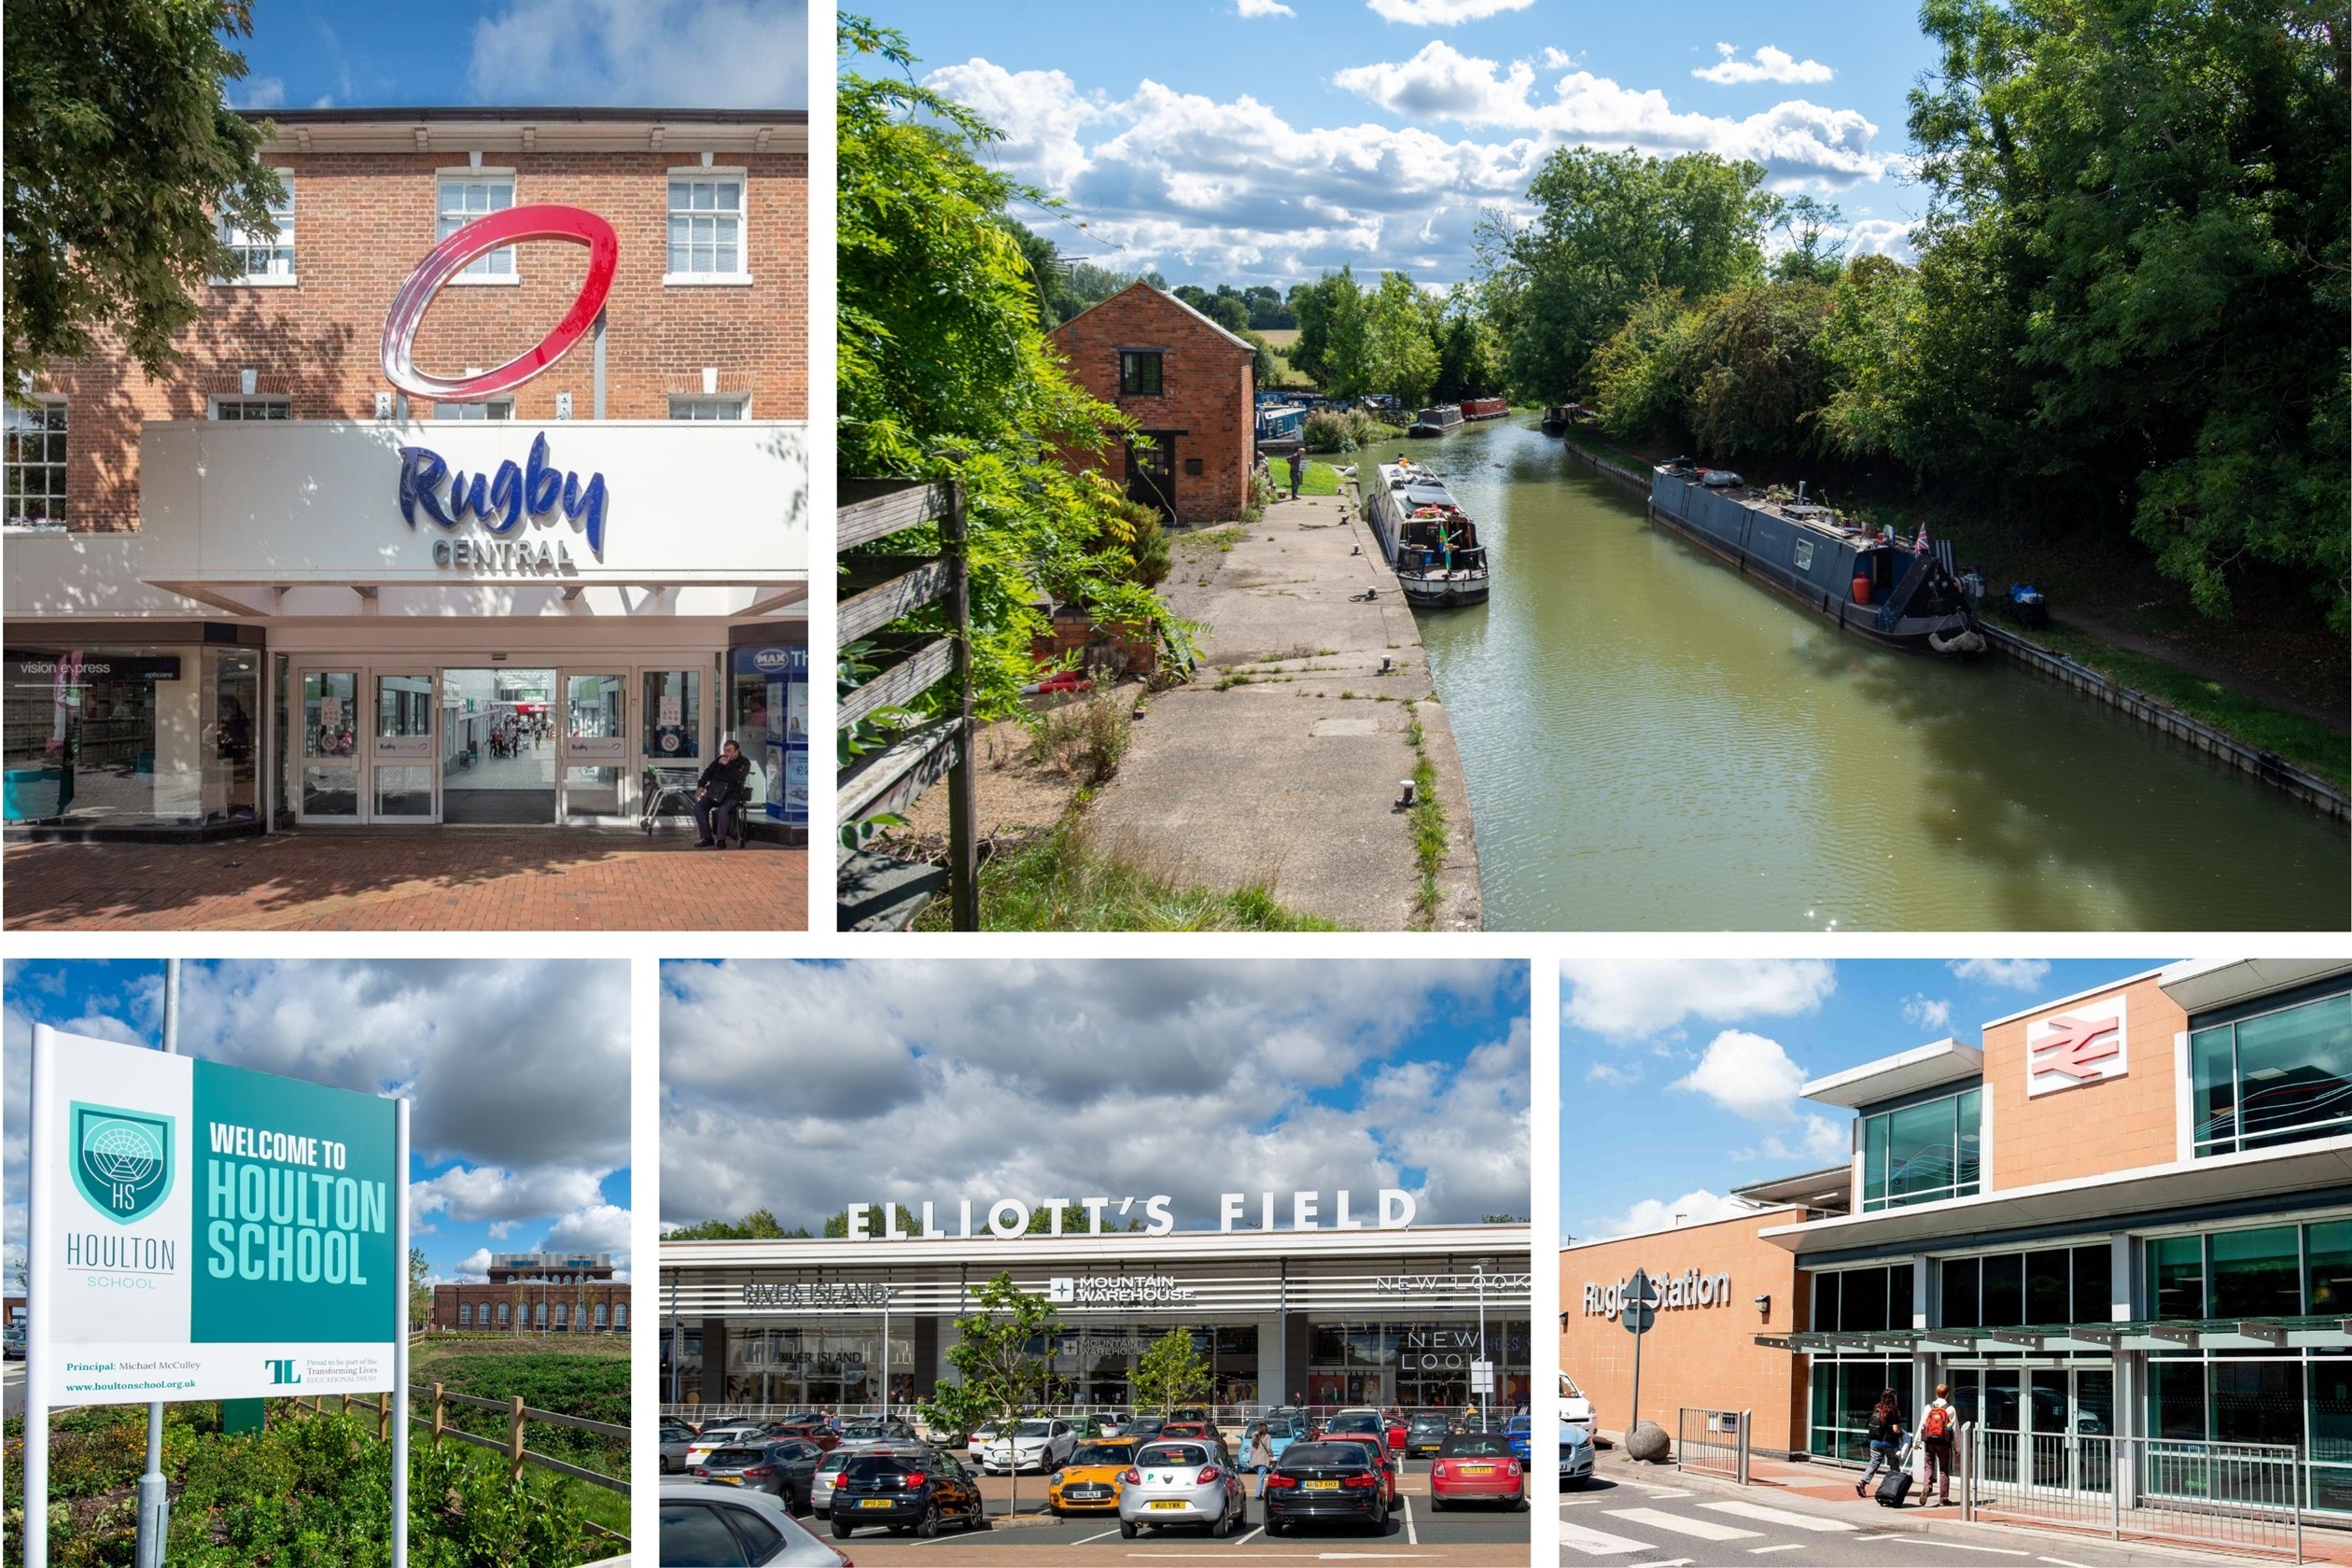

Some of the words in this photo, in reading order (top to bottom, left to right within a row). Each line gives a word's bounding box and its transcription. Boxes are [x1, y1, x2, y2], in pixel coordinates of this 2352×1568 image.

[398, 430, 606, 554] Rugby
[432, 539, 575, 567] CENTRAL
[757, 653, 785, 664] MAX
[21, 661, 57, 674] vision
[144, 671, 174, 679] opticians
[209, 1122, 317, 1167] WELCOME
[321, 1140, 346, 1170] TO
[112, 1183, 135, 1210] HS
[207, 1158, 386, 1234] HOULTON
[847, 1195, 1175, 1241] ELLIOTT'S
[1221, 1188, 1417, 1234] FIELD
[67, 1233, 175, 1270] HOULTON
[207, 1220, 368, 1285] SCHOOL
[87, 1276, 157, 1290] SCHOOL
[1079, 1275, 1175, 1288] MOUNTAIN
[1376, 1275, 1438, 1291] NEW
[1453, 1273, 1530, 1290] LOOK
[743, 1283, 802, 1304] RIVER
[810, 1282, 888, 1304] ISLAND
[1077, 1289, 1194, 1302] WAREHOUSE
[1583, 1277, 1631, 1319] Rugb
[1647, 1267, 1731, 1309] Station
[1079, 1339, 1139, 1348] MOUNTAIN
[1408, 1331, 1479, 1348] NEW
[778, 1351, 812, 1364] RIVER
[818, 1351, 862, 1364] ISLAND
[1078, 1348, 1151, 1356] WAREHOUSE
[66, 1362, 117, 1373] Principal:
[119, 1362, 157, 1370] Michael
[159, 1361, 202, 1371] McCulley
[306, 1366, 357, 1376] Transforming
[65, 1379, 197, 1392] www.houltonschool.org.uk
